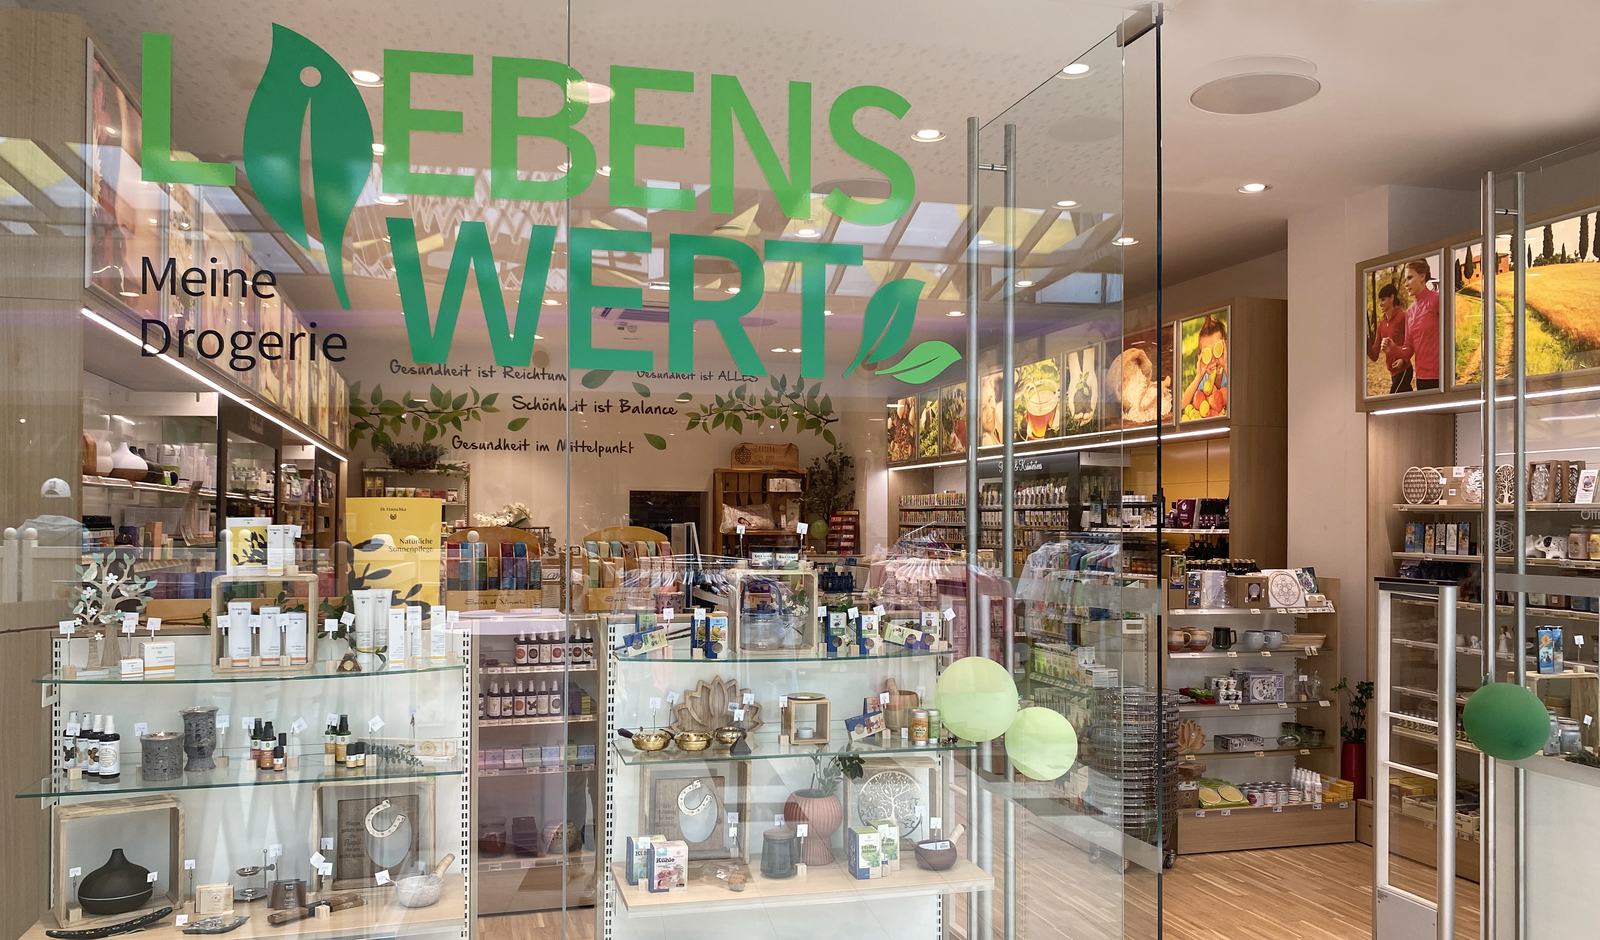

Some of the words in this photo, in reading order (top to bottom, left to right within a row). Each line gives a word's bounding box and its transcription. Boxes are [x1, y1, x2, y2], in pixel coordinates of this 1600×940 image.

[141, 256, 277, 299] Meine
[386, 217, 864, 380] WERT
[141, 318, 348, 372] Drogerie
[389, 358, 472, 377] Gesundheit
[477, 369, 497, 379] ist
[503, 365, 567, 382] Reichtum
[700, 371, 714, 382] ist
[511, 395, 588, 413] Schönhit
[593, 398, 613, 414] ist
[618, 398, 679, 416] Balance
[451, 434, 530, 452] Gesundheit
[536, 440, 551, 452] im
